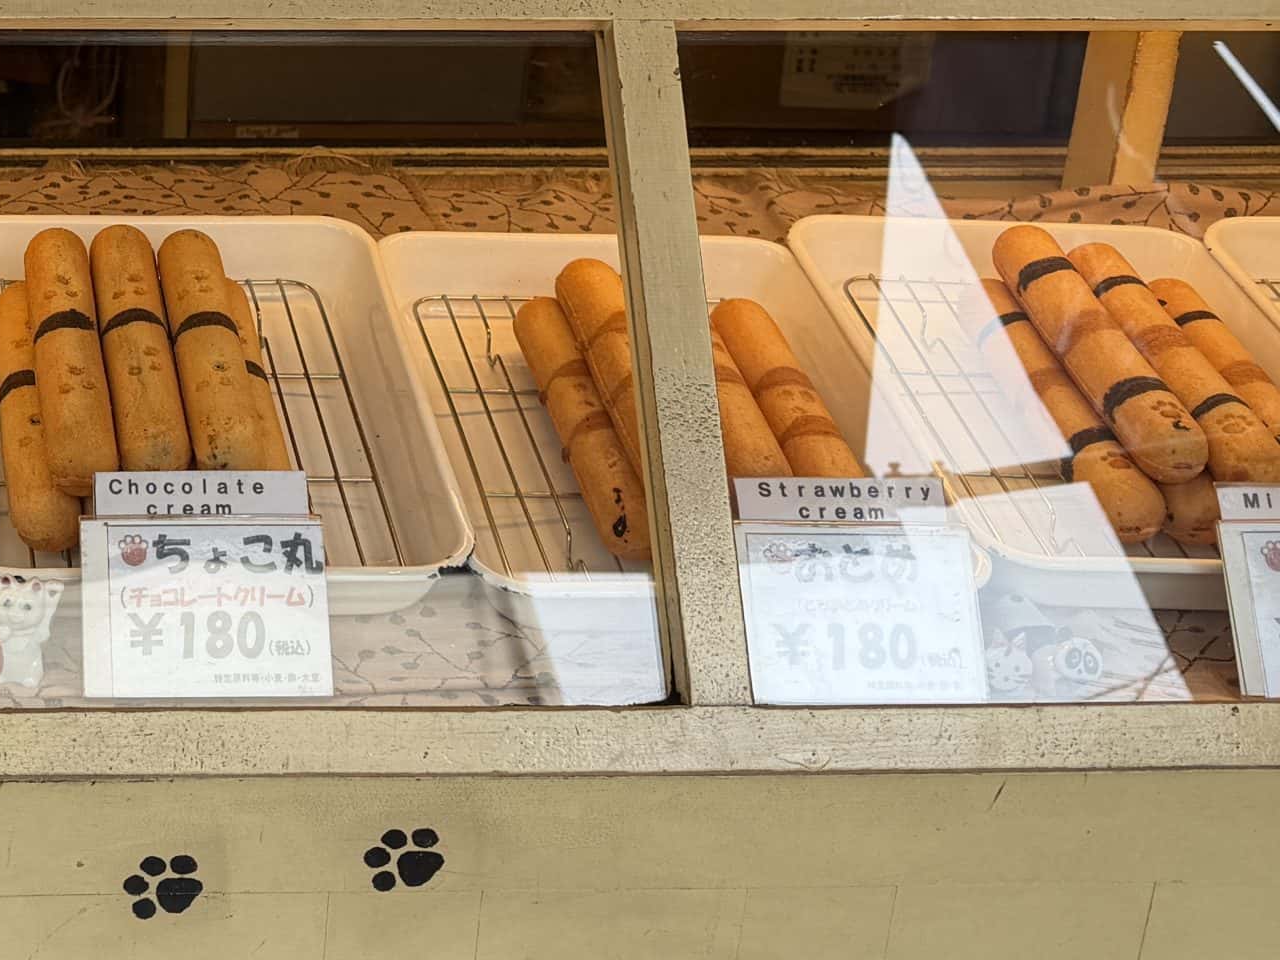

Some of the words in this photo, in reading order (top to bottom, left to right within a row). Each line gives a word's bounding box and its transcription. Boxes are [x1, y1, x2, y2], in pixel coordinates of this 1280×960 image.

[109, 478, 265, 495] Chocolate
[757, 482, 930, 500] Strawberry
[146, 503, 232, 515] cream
[798, 506, 884, 520] cream
[152, 532, 323, 574] ちょこ丸
